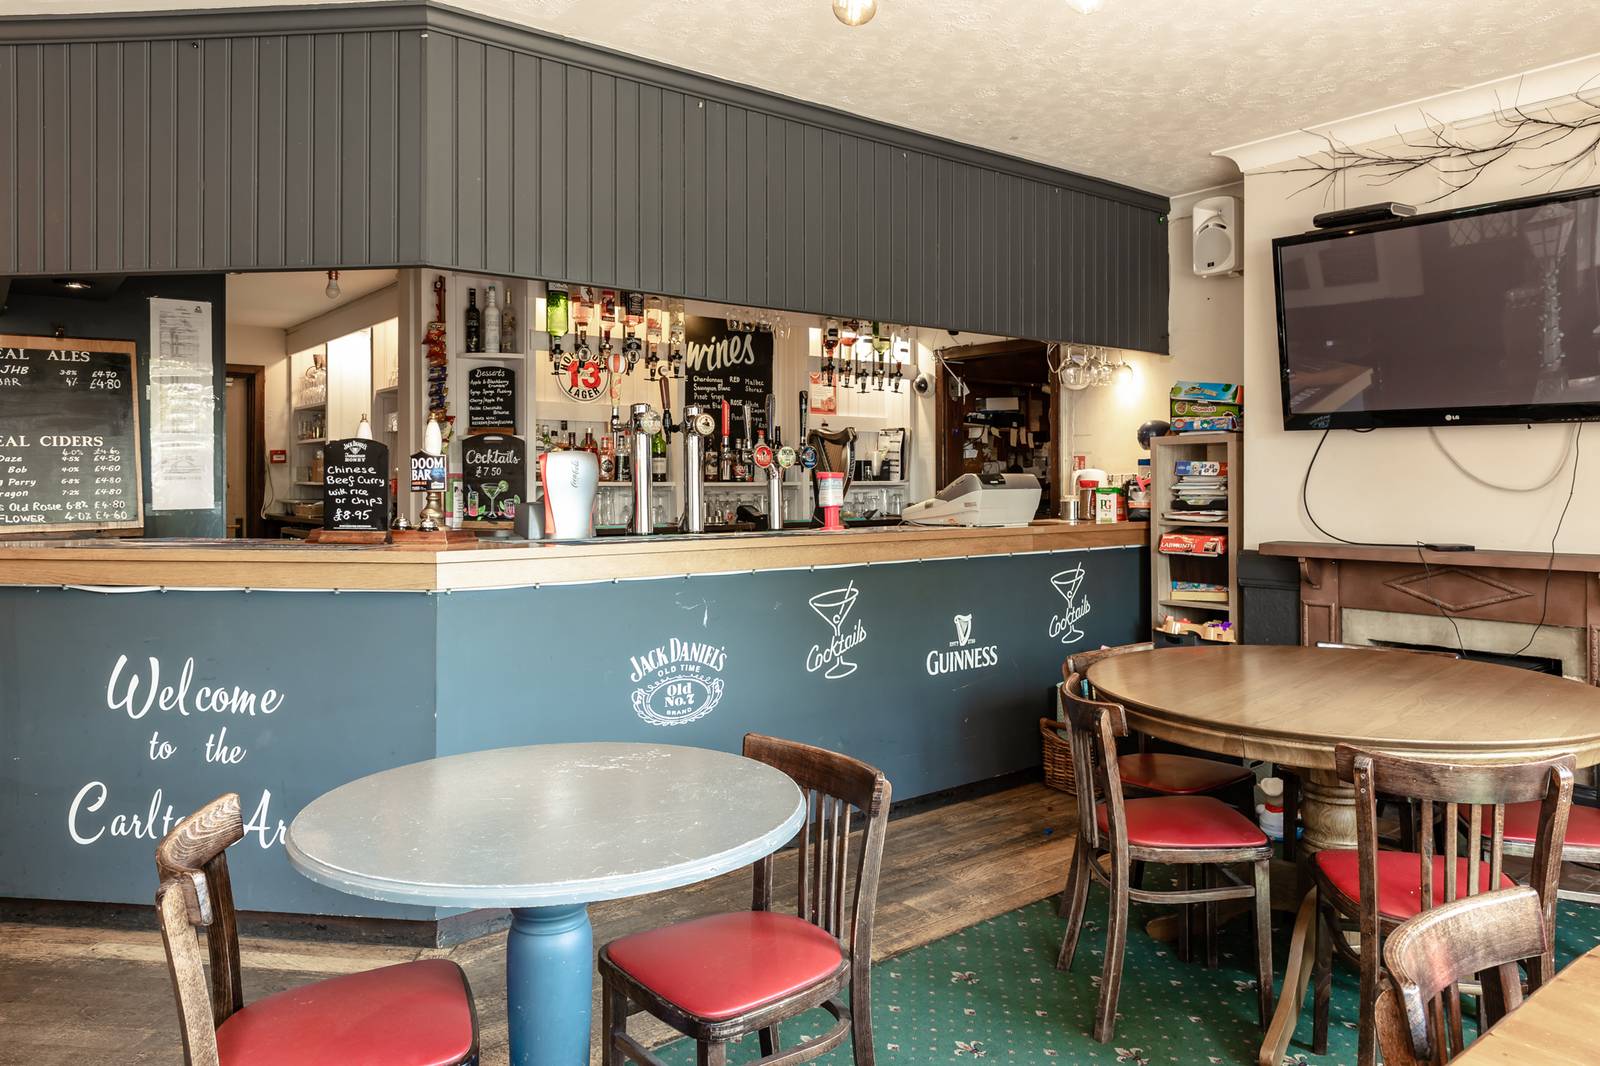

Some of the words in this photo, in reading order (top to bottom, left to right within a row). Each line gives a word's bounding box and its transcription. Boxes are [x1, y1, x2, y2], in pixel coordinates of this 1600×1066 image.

[47, 350, 91, 362] ALES
[687, 334, 755, 371] wines
[0, 364, 30, 374] JHB
[567, 360, 602, 389] 13
[89, 378, 122, 390] £4.80
[568, 385, 601, 399] LAGER
[39, 435, 105, 447] CIDERS
[411, 457, 444, 470] DOOM
[465, 449, 521, 465] Cocktails
[8, 465, 28, 474] Bob
[327, 465, 377, 475] Chinese
[411, 469, 433, 481] BAR
[8, 477, 37, 487] Perry
[326, 475, 355, 487] Beef
[357, 475, 386, 487] Curry
[350, 488, 369, 496] rice
[8, 502, 30, 512] Old
[32, 501, 64, 511] Rosie
[333, 508, 373, 522] £8.95
[1048, 594, 1091, 638] Cocktails
[806, 618, 867, 672] Cocktails
[629, 645, 670, 683] JACK
[668, 637, 728, 672] DANIEL'S
[926, 645, 999, 676] GUINNESS
[657, 664, 678, 678] OLD
[680, 663, 702, 673] TIME
[106, 654, 285, 720] Welcome
[666, 682, 693, 697] Old
[666, 706, 693, 716] BRAND
[149, 730, 178, 761] to
[205, 726, 248, 764] the
